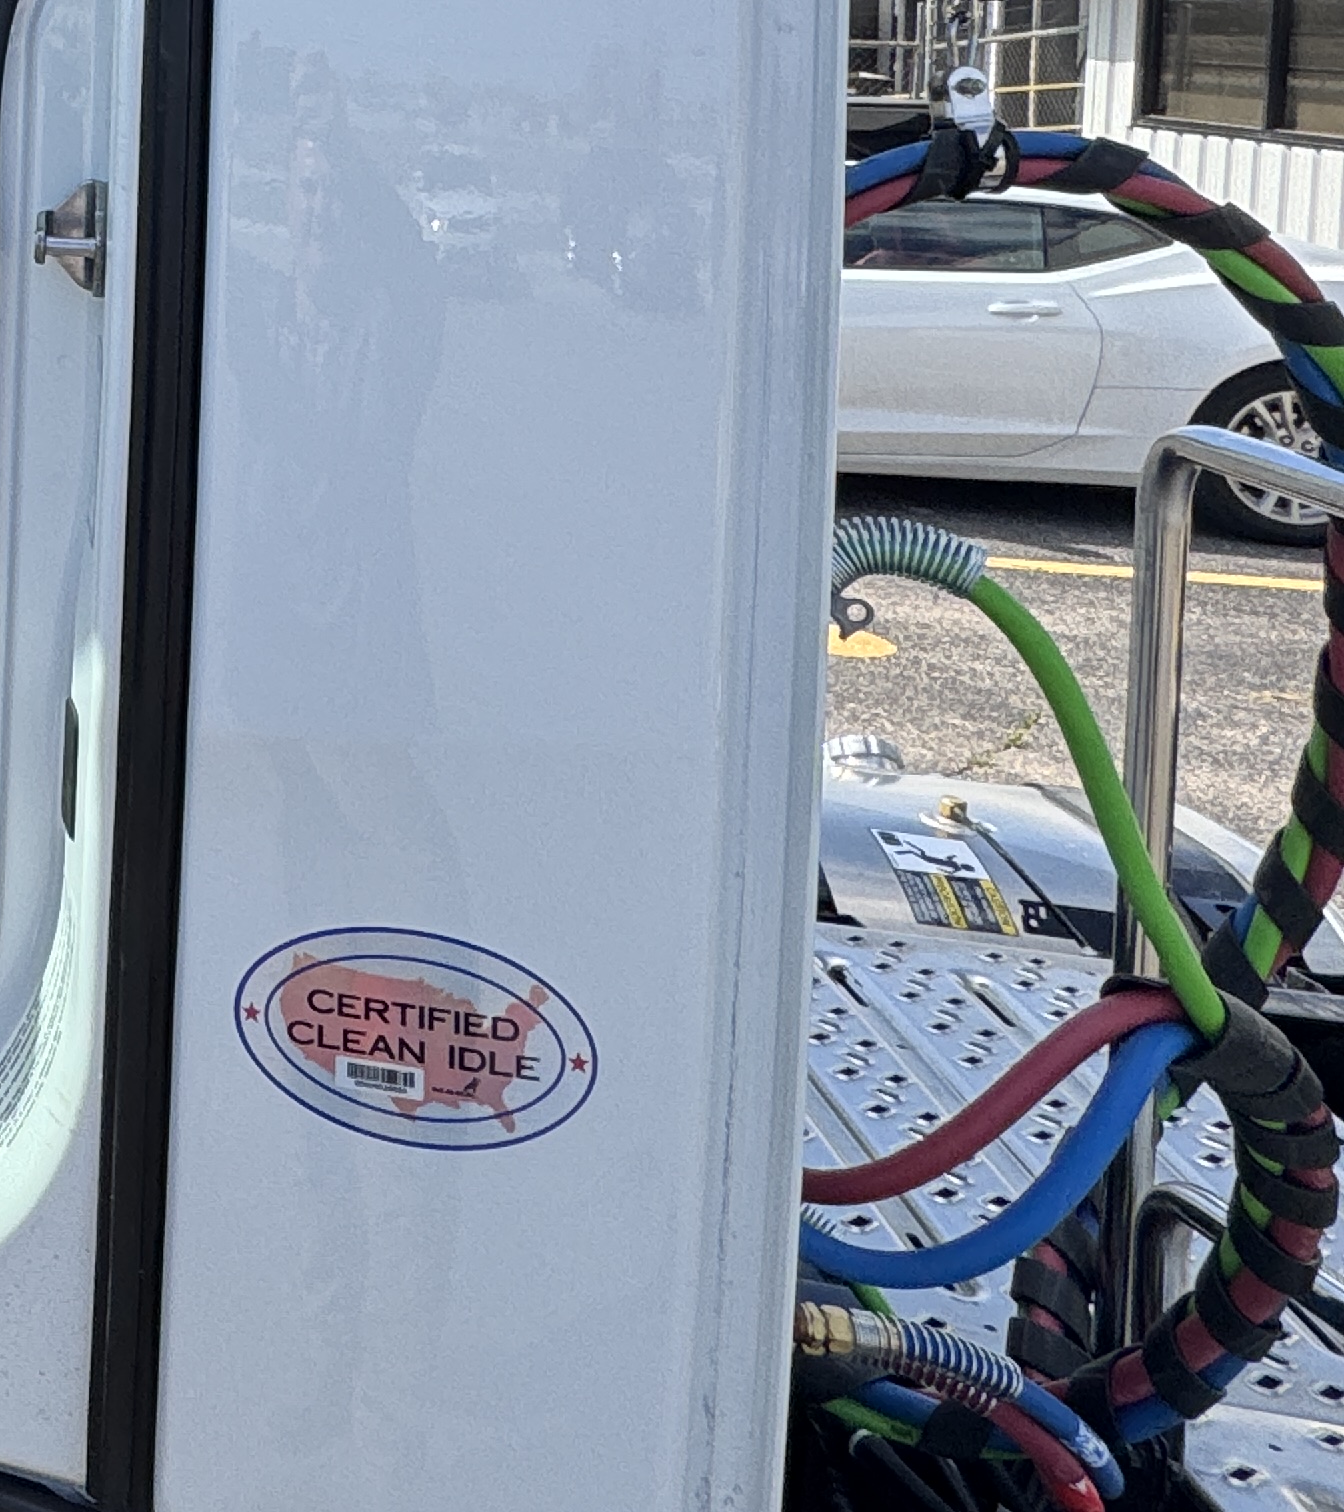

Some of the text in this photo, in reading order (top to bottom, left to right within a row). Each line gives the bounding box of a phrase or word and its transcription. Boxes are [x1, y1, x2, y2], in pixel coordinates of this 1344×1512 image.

[306, 988, 520, 1042] CERTIFIED
[286, 1020, 541, 1082] CLEAN IDLE
